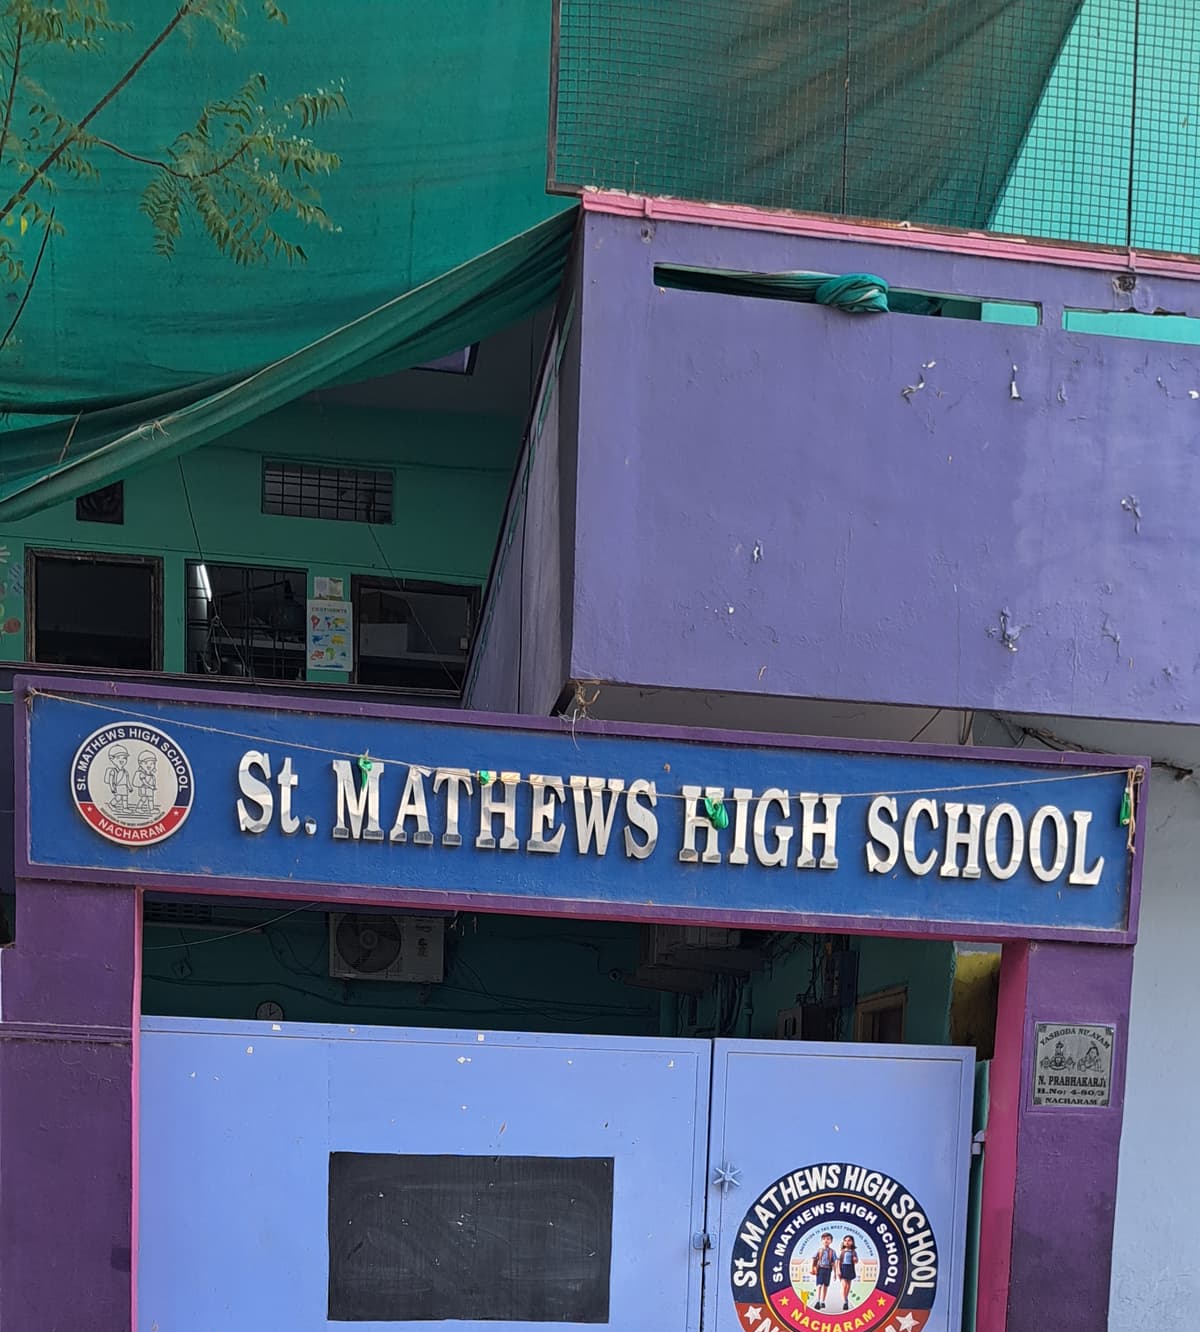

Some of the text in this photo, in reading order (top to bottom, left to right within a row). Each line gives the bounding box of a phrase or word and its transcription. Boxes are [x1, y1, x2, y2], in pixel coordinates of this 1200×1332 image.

[78, 728, 126, 772] MATHEWS
[129, 728, 160, 745] HIGH
[160, 742, 189, 792] SCHOOL
[98, 818, 166, 840] NACHARAM
[236, 750, 1105, 886] St. MATHEWS HIGH SCHOOL
[1040, 1028, 1076, 1046] YASHODA
[1045, 1097, 1097, 1105] NACHARAM
[773, 1202, 898, 1286] St. MATHEWS HIGH SCHOOL
[843, 1165, 898, 1206] HIGH
[891, 1193, 937, 1296] SCHOOL
